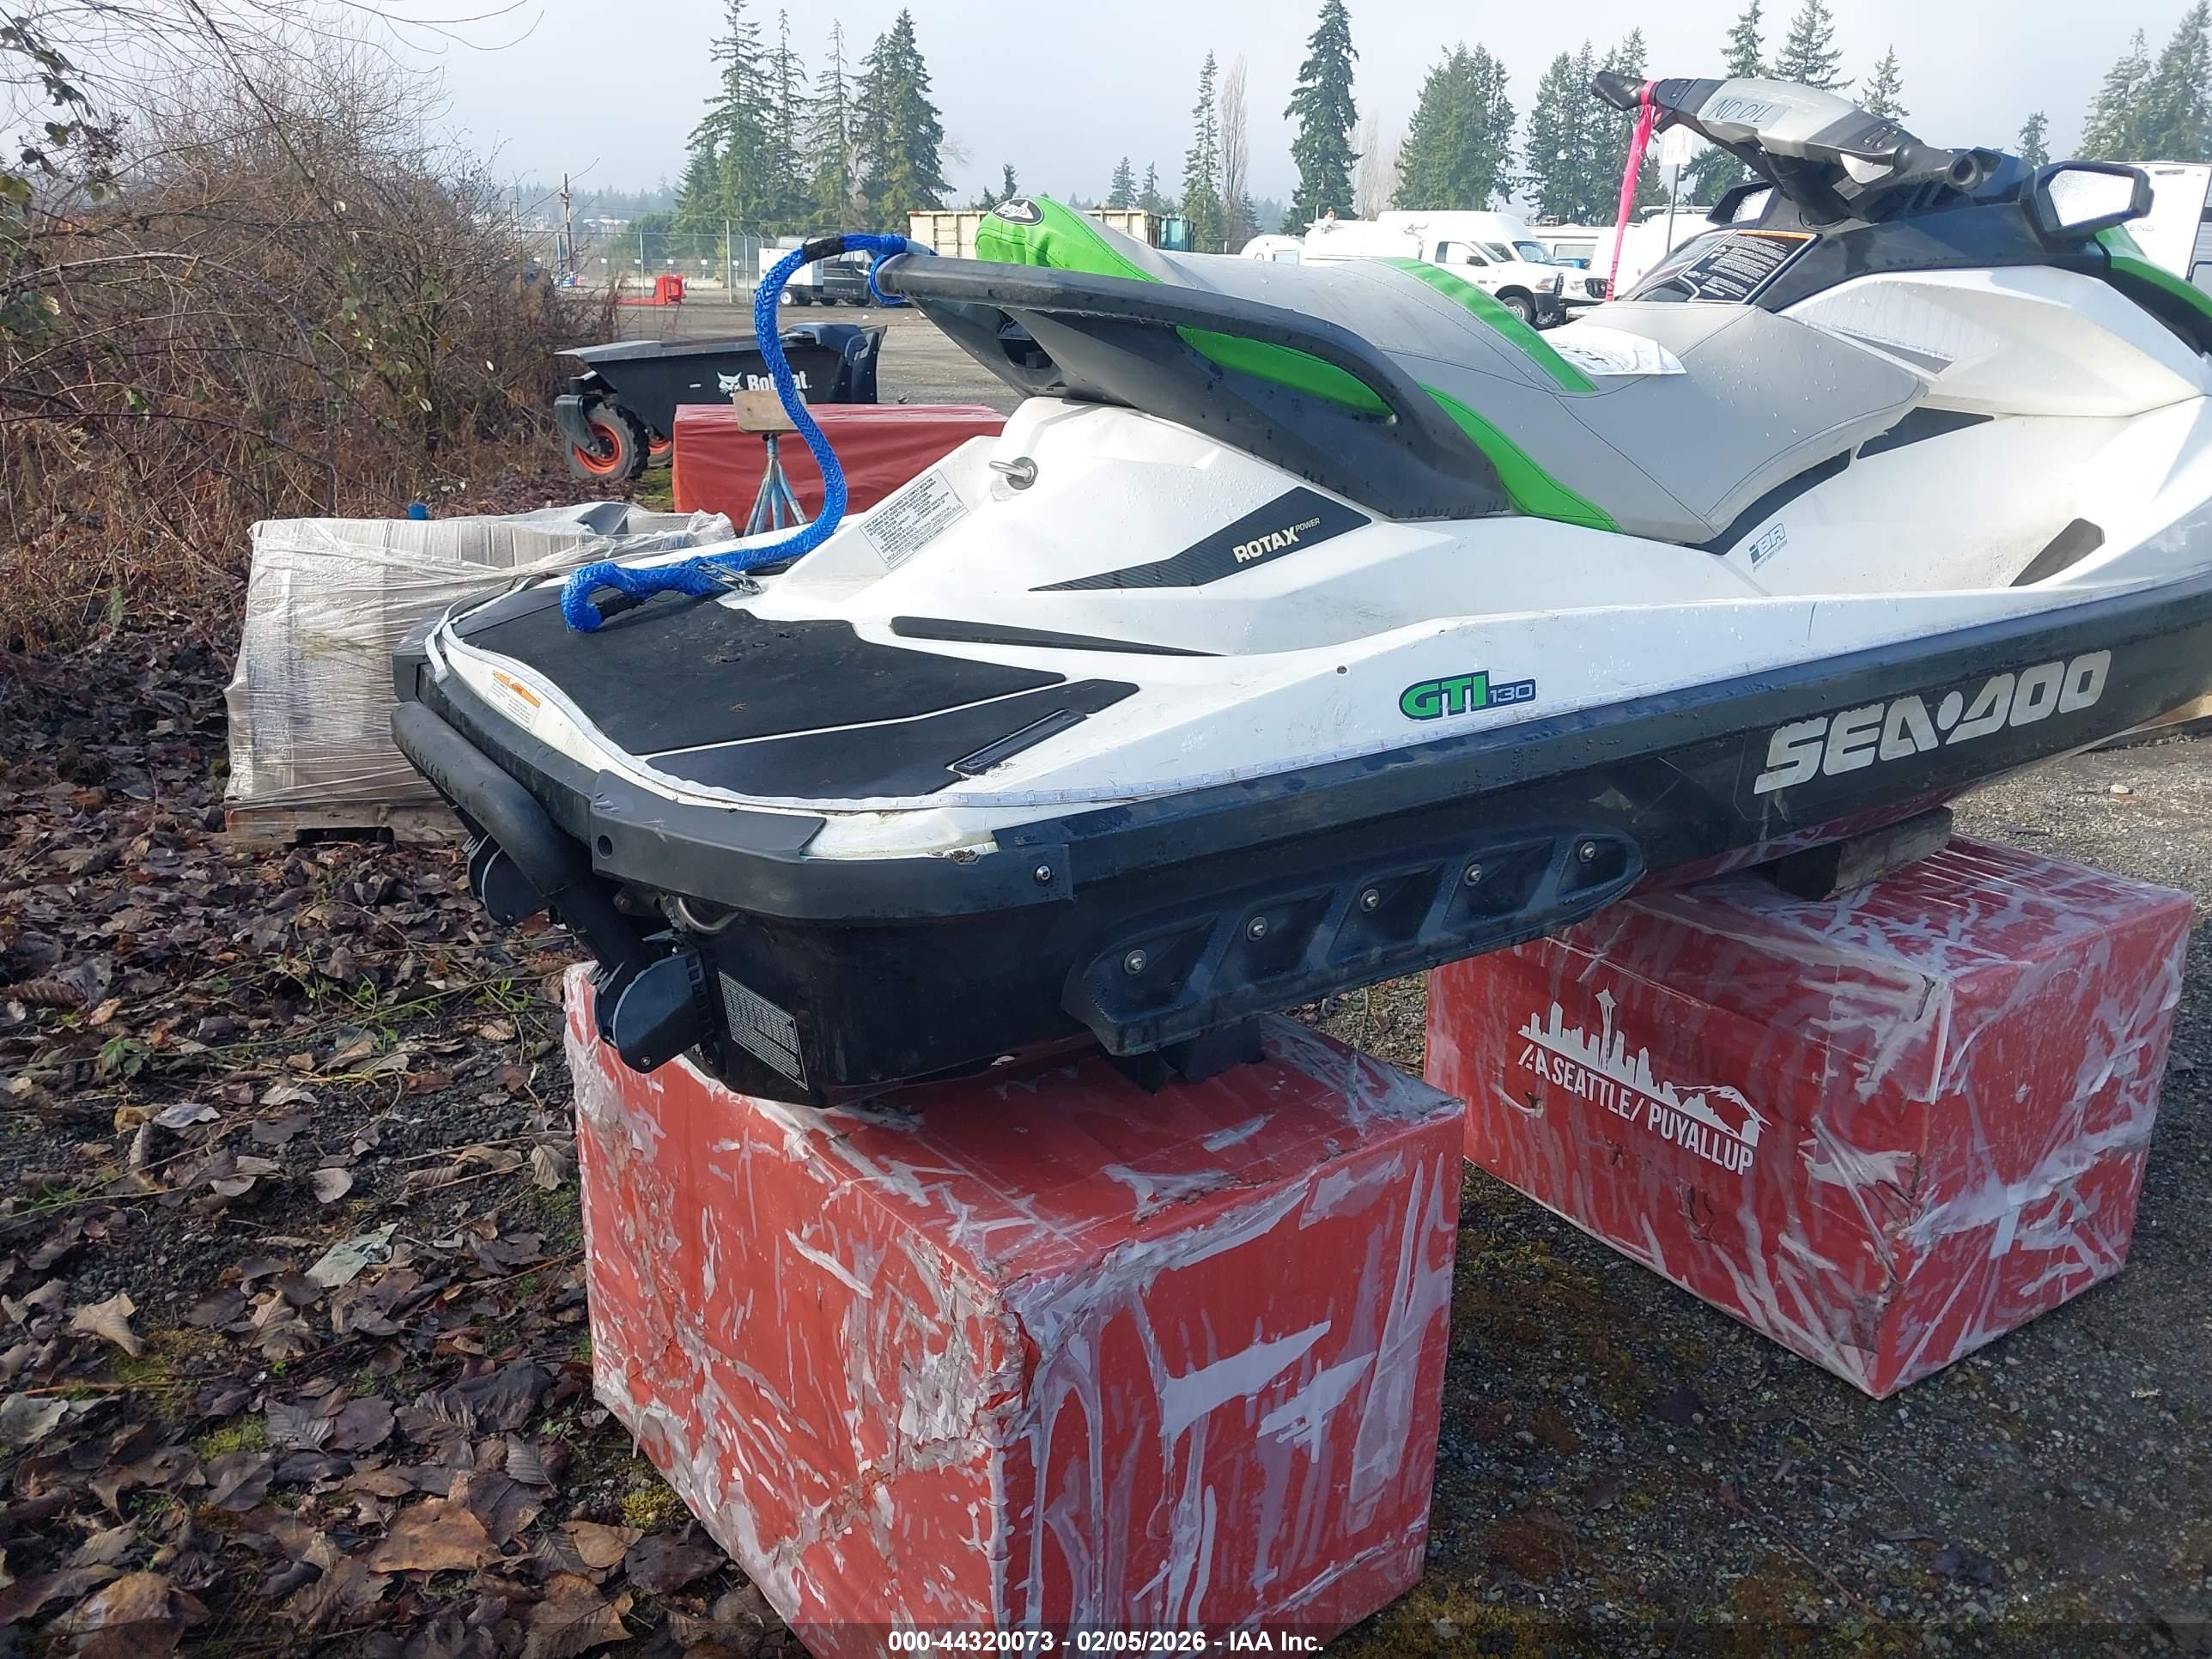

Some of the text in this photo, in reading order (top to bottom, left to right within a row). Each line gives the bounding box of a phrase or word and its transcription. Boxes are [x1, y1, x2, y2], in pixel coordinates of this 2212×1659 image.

[1706, 99, 1773, 122] NO OIL
[1232, 517, 1321, 563] ROTAX POWER
[1401, 672, 1533, 719] GTI 130
[1648, 1102, 1754, 1176] PUYALLUP
